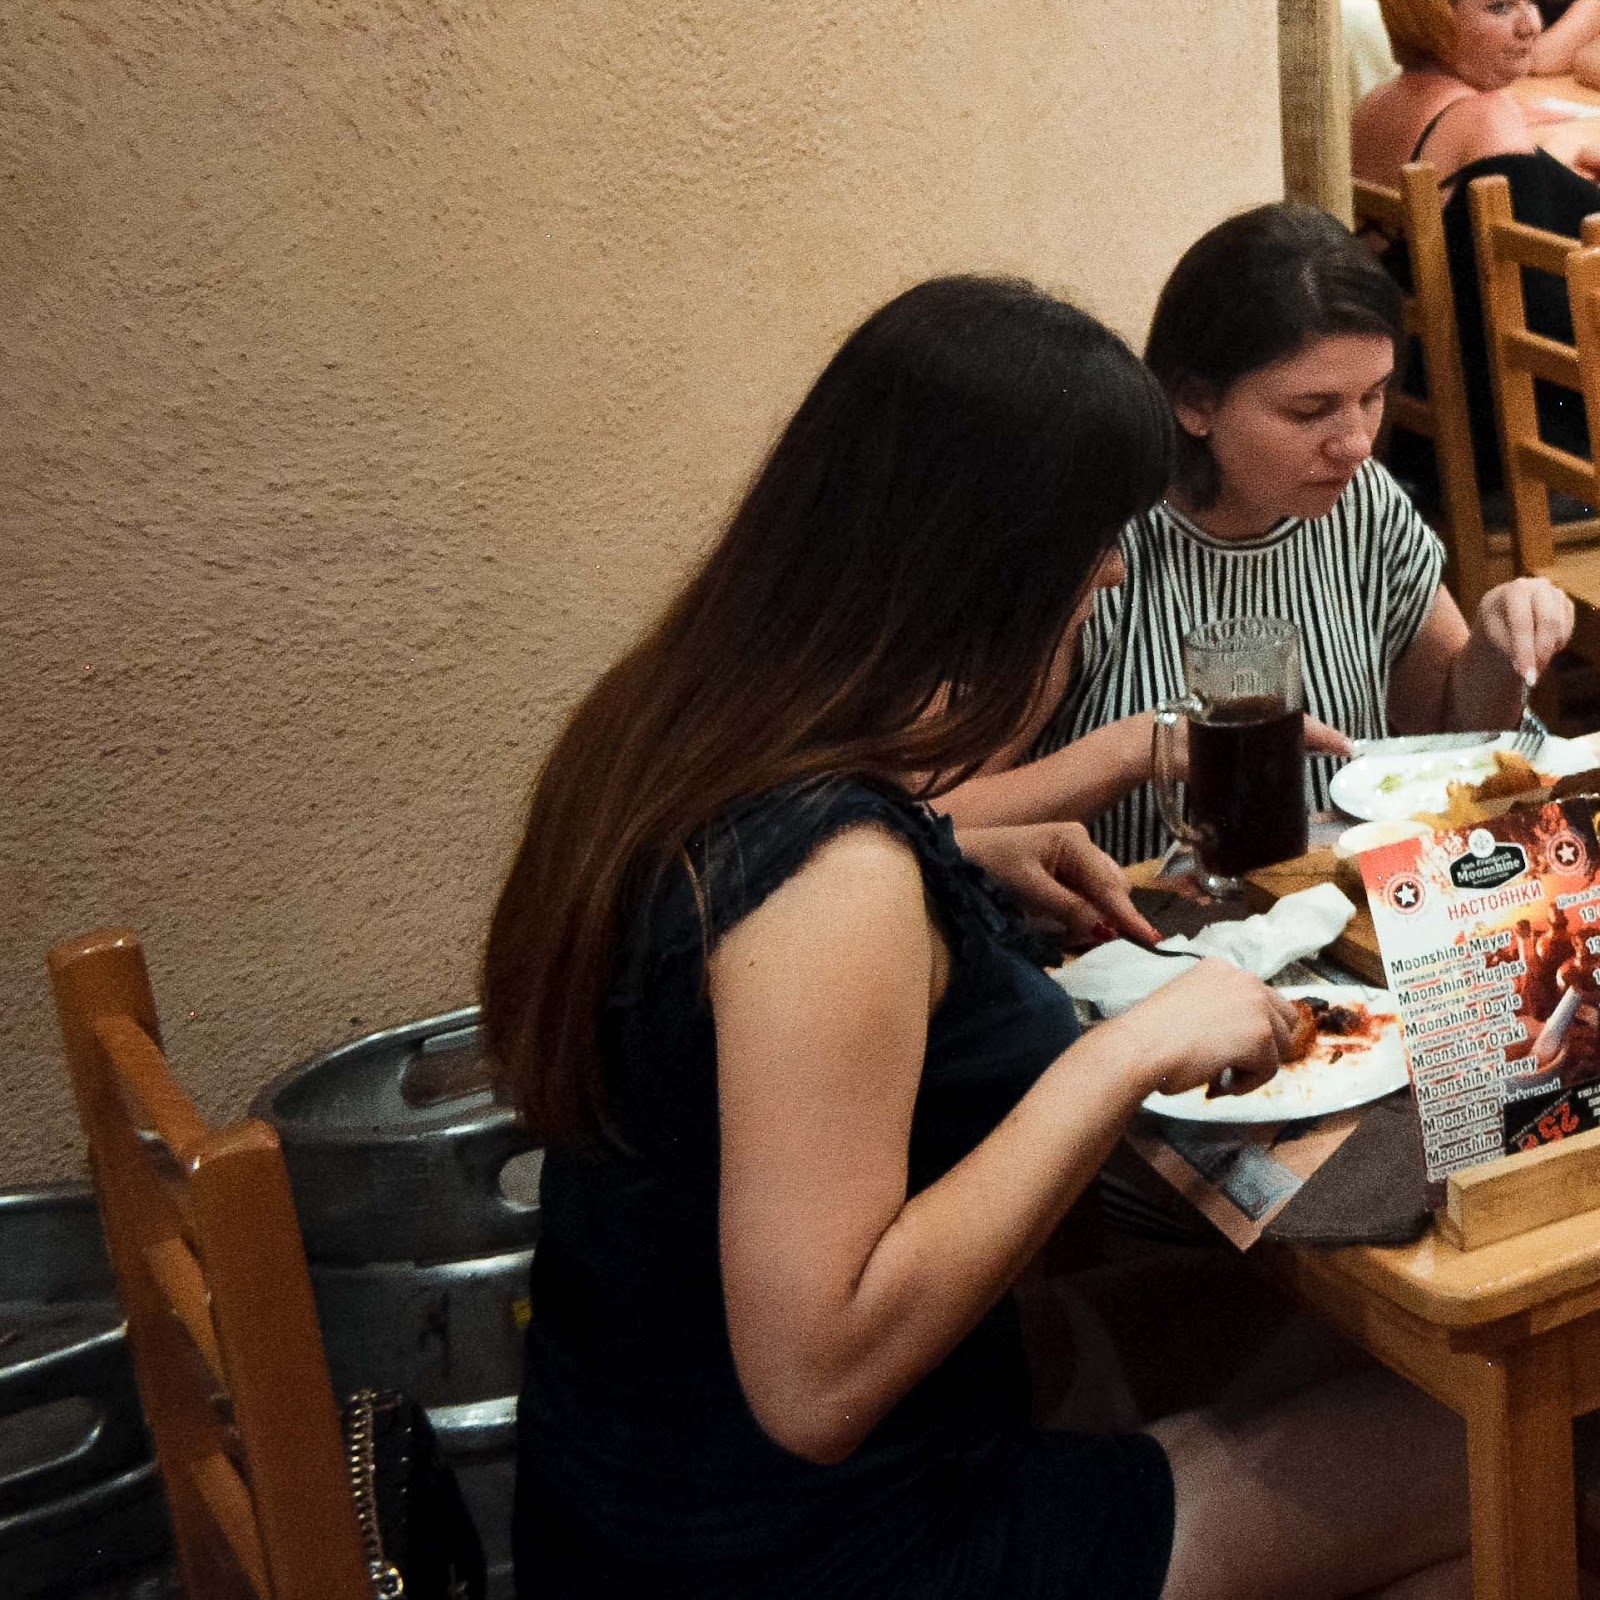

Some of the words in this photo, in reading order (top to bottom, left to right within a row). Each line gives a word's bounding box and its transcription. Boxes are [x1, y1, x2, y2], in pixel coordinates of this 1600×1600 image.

[1457, 859, 1520, 883] Moonshine
[1447, 881, 1542, 920] НАСТОЯНКИ
[1391, 945, 1465, 974] Moonshine
[1469, 932, 1511, 954] Meyer
[1398, 976, 1472, 1006] Moonshine
[1476, 961, 1526, 985] Hughes
[1405, 1008, 1479, 1038] Moonshine
[1483, 995, 1520, 1016] Doyle
[1412, 1039, 1485, 1069] Moonshine
[1489, 1023, 1526, 1047] Ozaki
[1418, 1070, 1491, 1100] Moonshine
[1496, 1056, 1537, 1077] Honey
[1423, 1102, 1496, 1132] Moonshine
[1427, 1132, 1501, 1167] Moonshine
